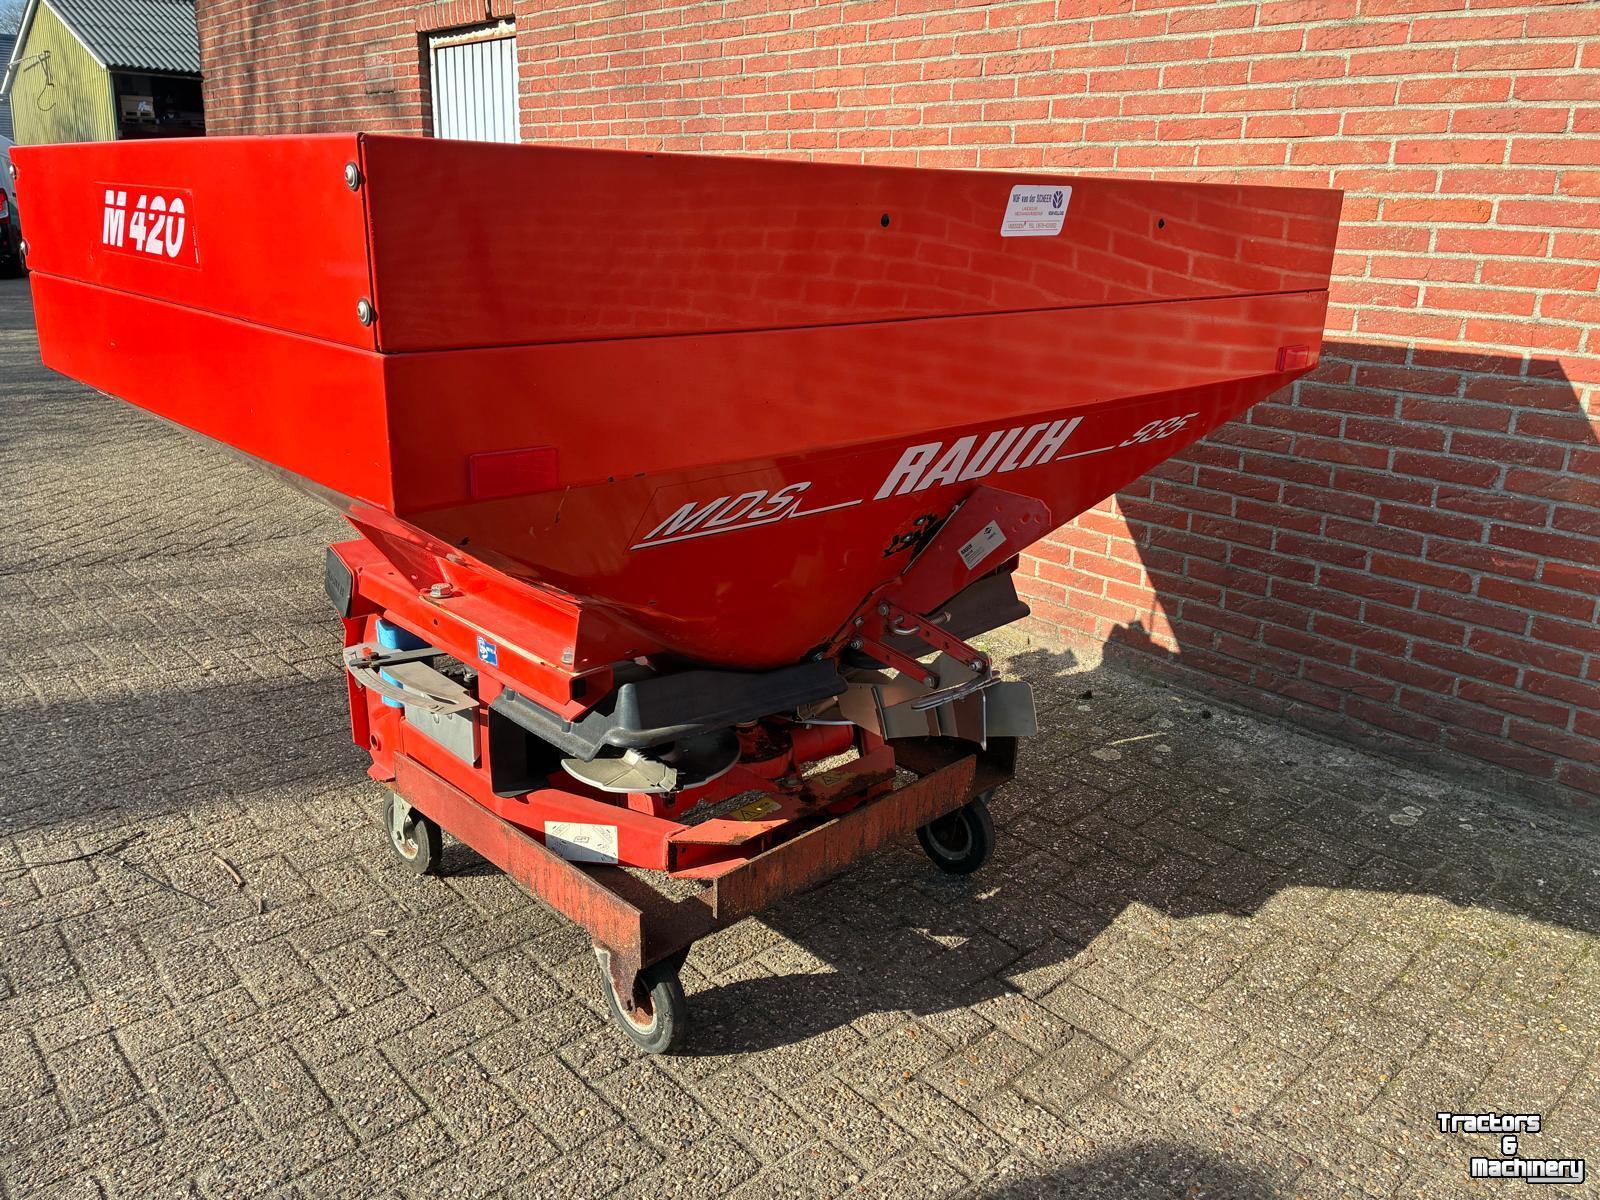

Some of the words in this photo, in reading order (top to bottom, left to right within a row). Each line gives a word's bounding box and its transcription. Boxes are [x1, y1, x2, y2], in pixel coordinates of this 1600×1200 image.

[102, 189, 127, 248] M
[129, 194, 186, 258] 420
[643, 481, 811, 540] MDS
[873, 416, 1085, 500] RAUCH
[1118, 411, 1200, 447] 935
